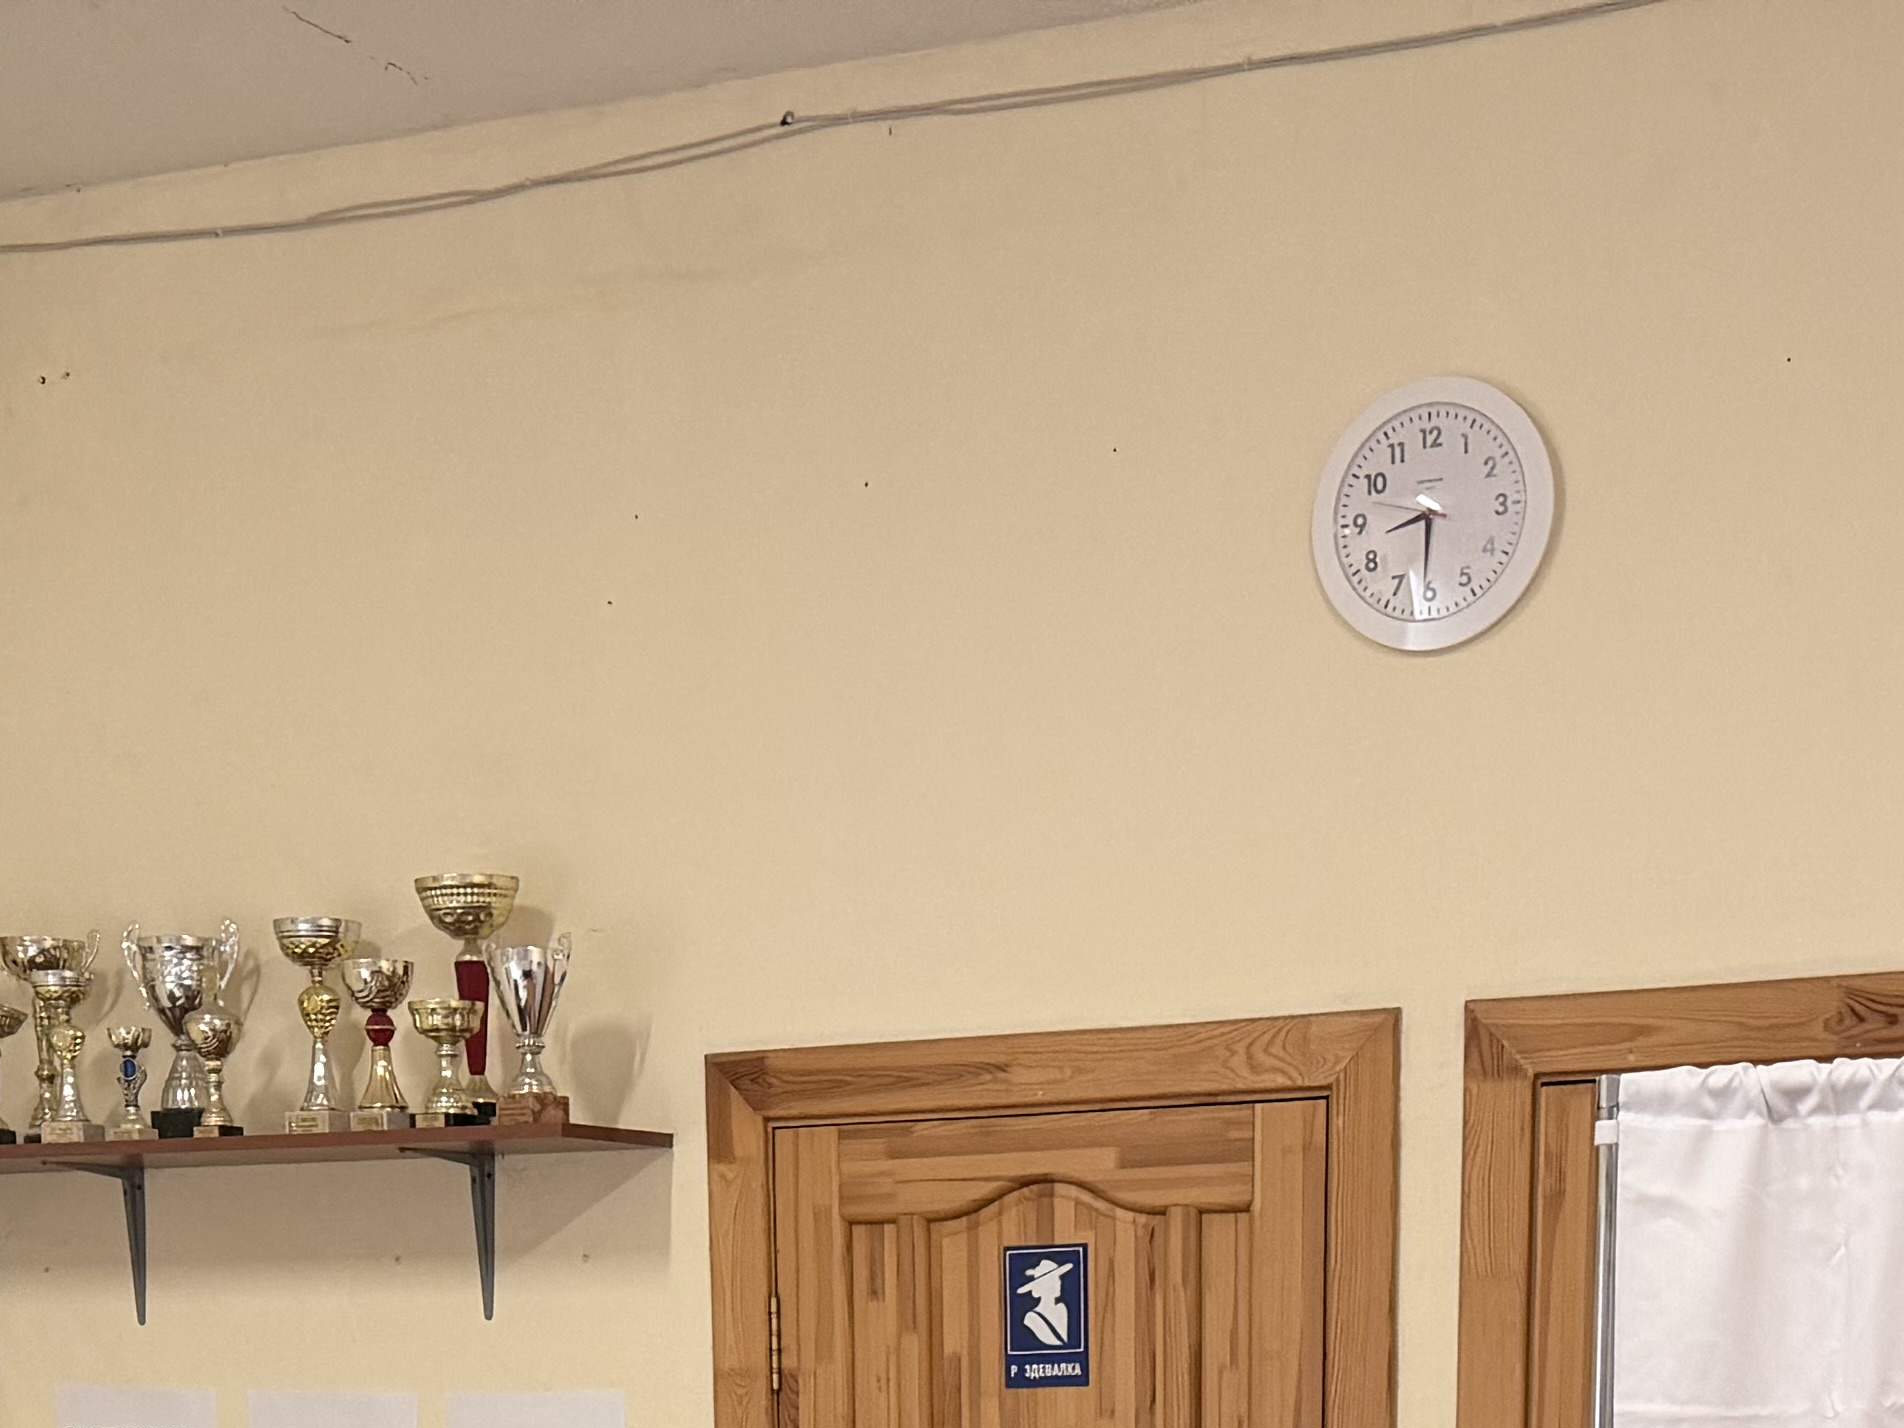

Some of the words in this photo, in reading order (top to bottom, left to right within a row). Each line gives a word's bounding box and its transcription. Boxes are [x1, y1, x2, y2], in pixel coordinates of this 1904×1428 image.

[1420, 426, 1443, 449] 12
[1461, 433, 1469, 454] 1
[1387, 442, 1406, 465] 11
[1484, 456, 1497, 479] 2
[1364, 472, 1387, 496] 10
[1494, 493, 1509, 516] 3
[1353, 513, 1367, 535] 9
[1482, 536, 1495, 556] 4
[1365, 550, 1378, 572] 8
[1391, 574, 1406, 597] 7
[1459, 566, 1472, 587] 5
[1423, 580, 1437, 602] 6
